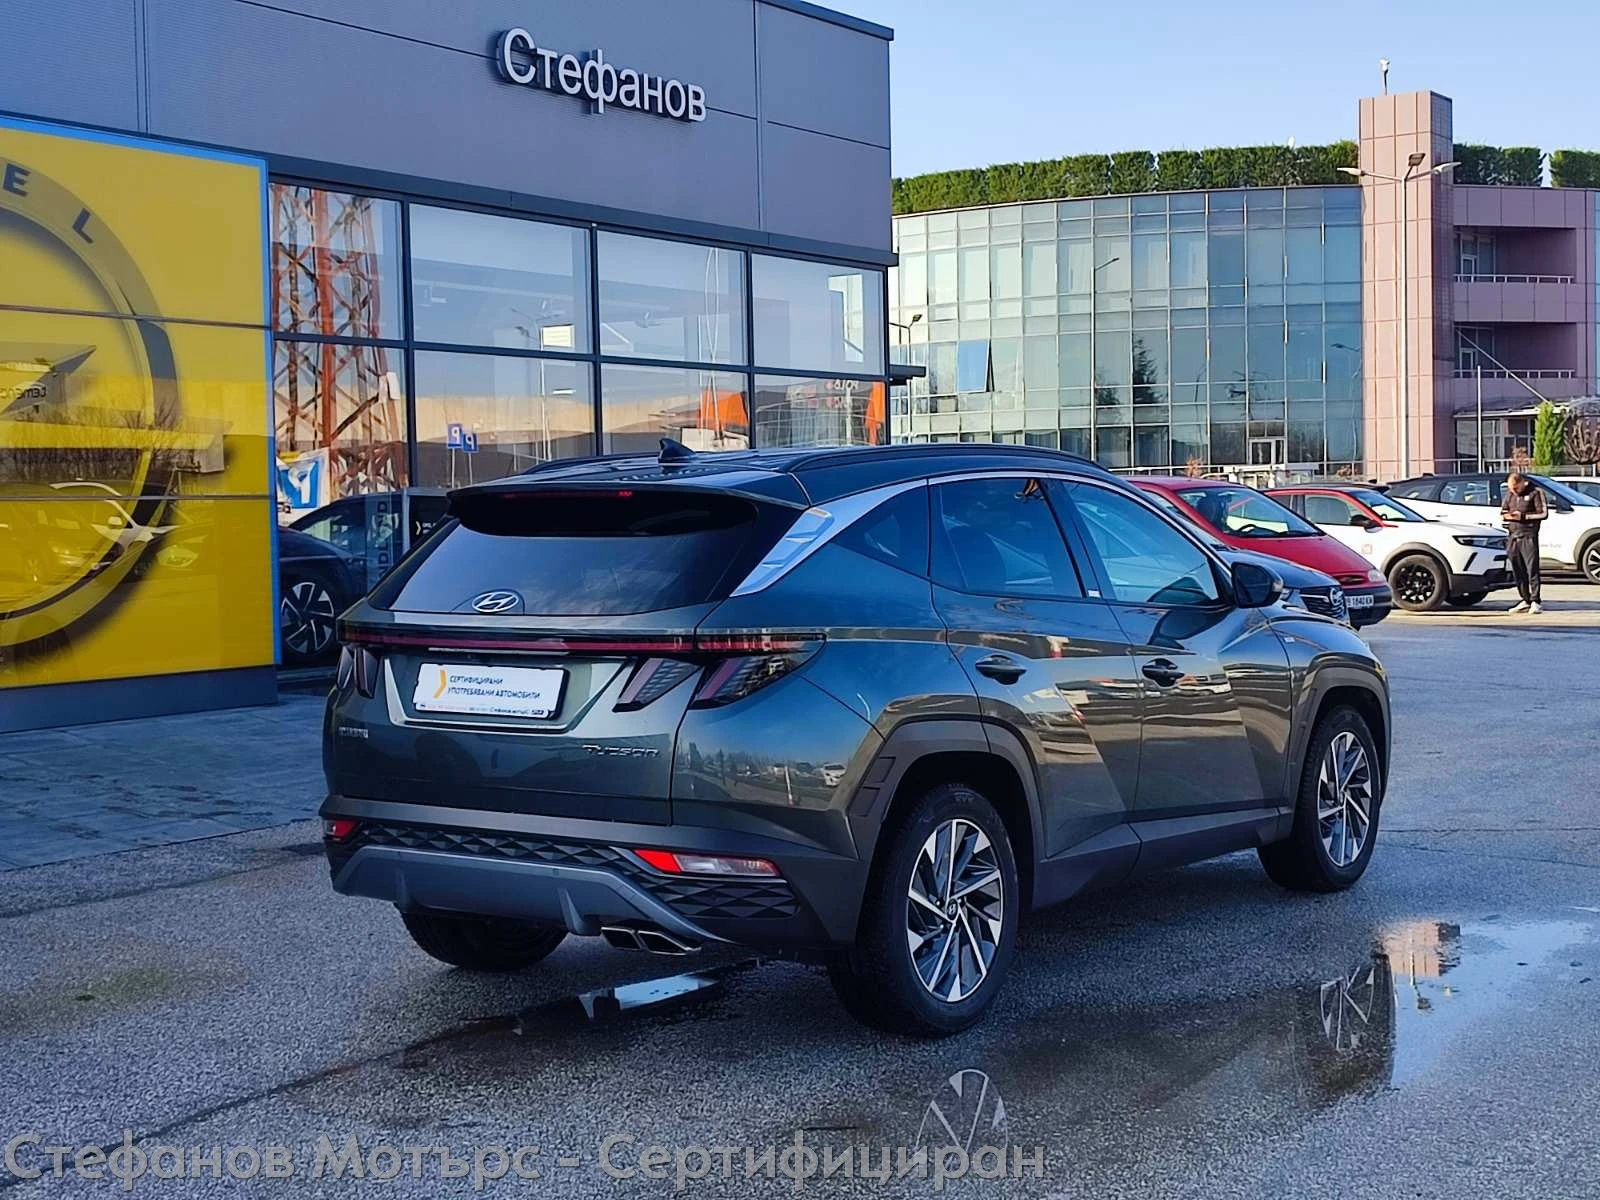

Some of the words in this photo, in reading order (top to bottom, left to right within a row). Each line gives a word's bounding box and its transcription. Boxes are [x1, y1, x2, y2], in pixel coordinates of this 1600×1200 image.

[500, 27, 707, 122] Стефанов
[449, 675, 504, 685] СЕРТИФИЦИРАНИ
[447, 686, 495, 697] УПОТРЕБЯВАНИ
[495, 689, 541, 699] АВТОМОБИЛИ
[582, 744, 658, 758] TUCSON
